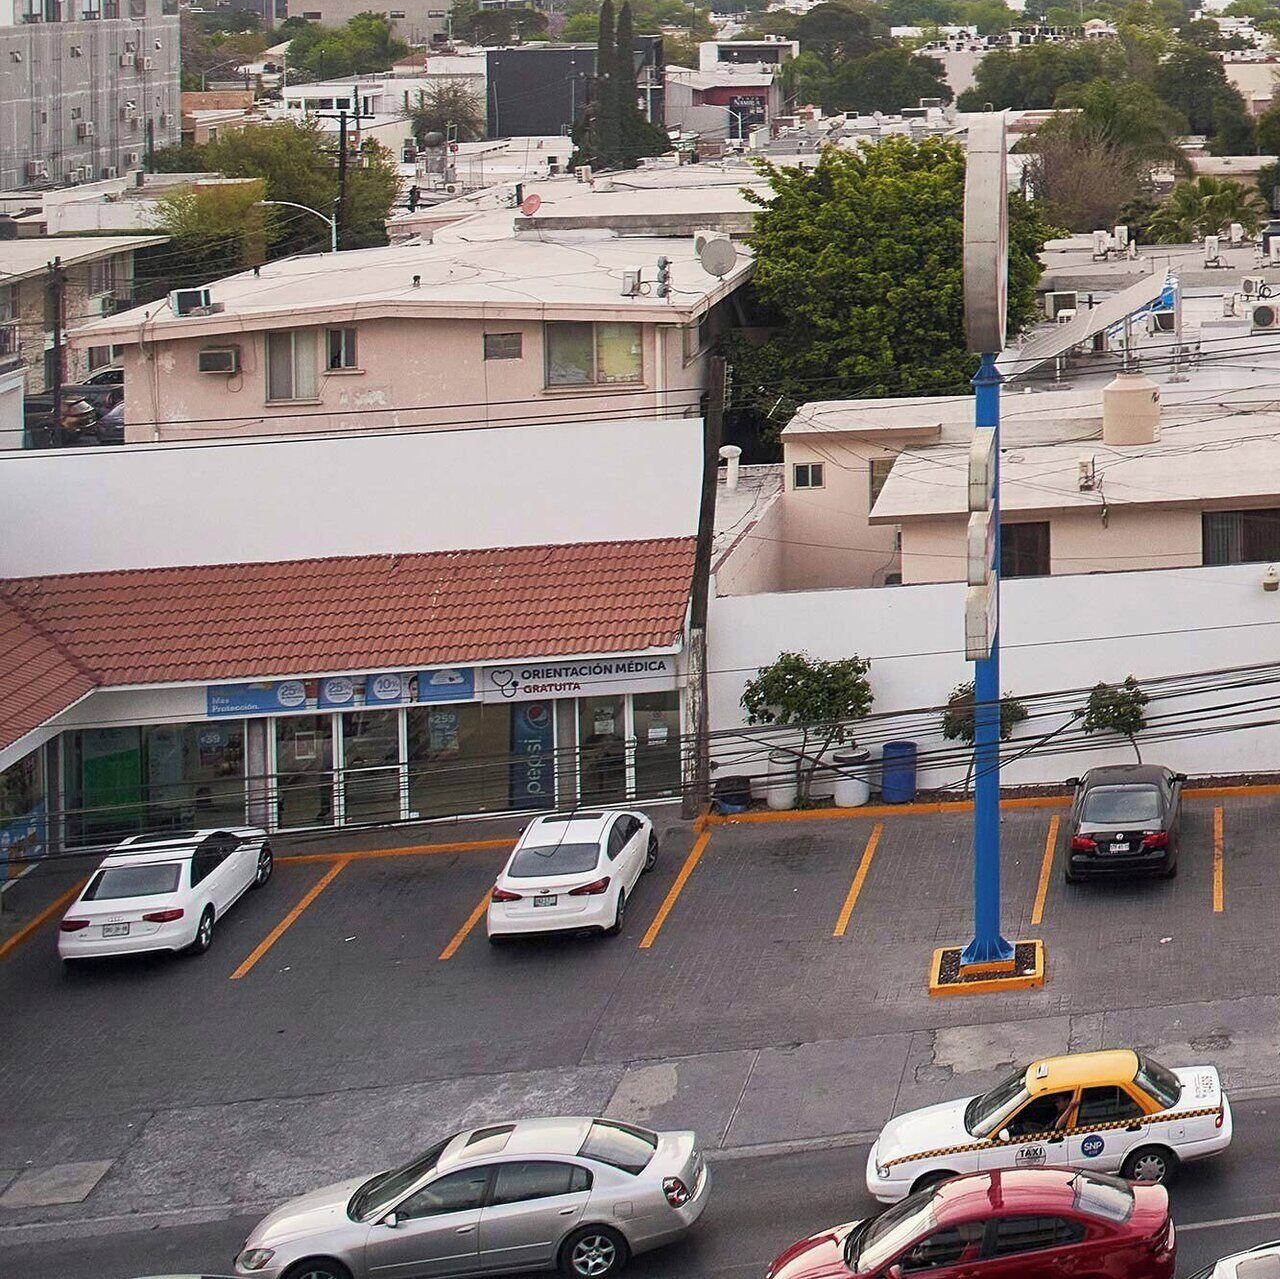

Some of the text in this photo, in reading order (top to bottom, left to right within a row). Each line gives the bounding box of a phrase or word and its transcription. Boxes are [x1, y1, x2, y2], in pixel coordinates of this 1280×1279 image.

[521, 660, 667, 681] ORIENTACIÓN MÉDICA
[523, 681, 581, 694] GRATUITA
[525, 737, 546, 795] pepsi
[1020, 1147, 1043, 1158] TAXI
[1084, 1141, 1103, 1151] SNP
